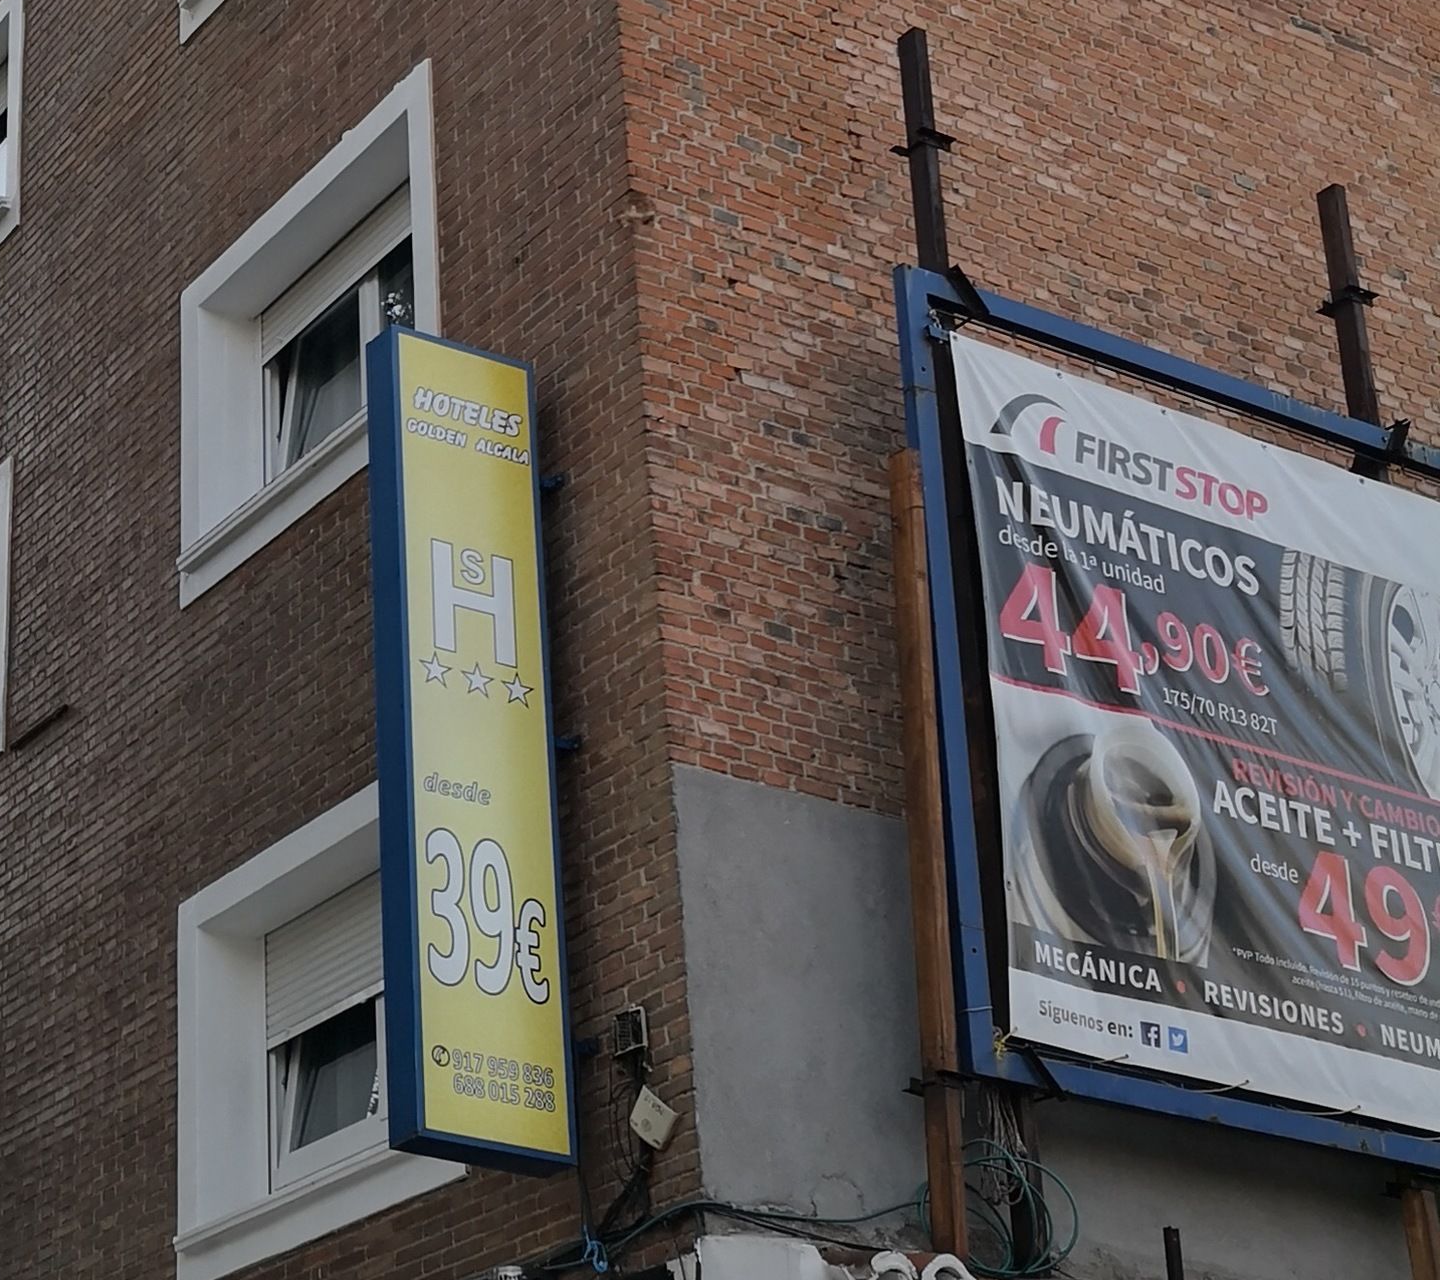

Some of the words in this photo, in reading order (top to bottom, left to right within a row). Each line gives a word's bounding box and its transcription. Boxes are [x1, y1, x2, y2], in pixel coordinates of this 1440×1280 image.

[413, 386, 522, 437] HOTELES
[407, 418, 467, 448] GOLDEN
[475, 439, 530, 466] ALCALA
[996, 477, 1259, 596] NEUMÁTICOS
[999, 524, 1058, 558] desde
[1063, 544, 1077, 563] la
[1102, 560, 1165, 594] unidad
[1162, 687, 1216, 717] 175/70
[1218, 703, 1248, 726] R13
[1250, 713, 1278, 736] 82T
[423, 772, 491, 805] desde
[1232, 758, 1337, 807] REVISIÓN
[1341, 790, 1353, 812] Y
[1213, 781, 1335, 846] ACEITE
[1370, 823, 1440, 873] FILT
[1250, 853, 1299, 884] desde
[425, 827, 549, 1004] 39€
[1035, 940, 1162, 993] MECÁNICA
[1204, 980, 1344, 1035] REVISIONES
[1039, 1000, 1103, 1033] Síguenos
[1107, 1019, 1133, 1039] en:
[452, 1048, 483, 1074] 917
[487, 1056, 520, 1081] 959
[522, 1063, 555, 1088] 836
[453, 1073, 485, 1099] 688
[488, 1082, 520, 1105] 015
[524, 1087, 556, 1112] 288
